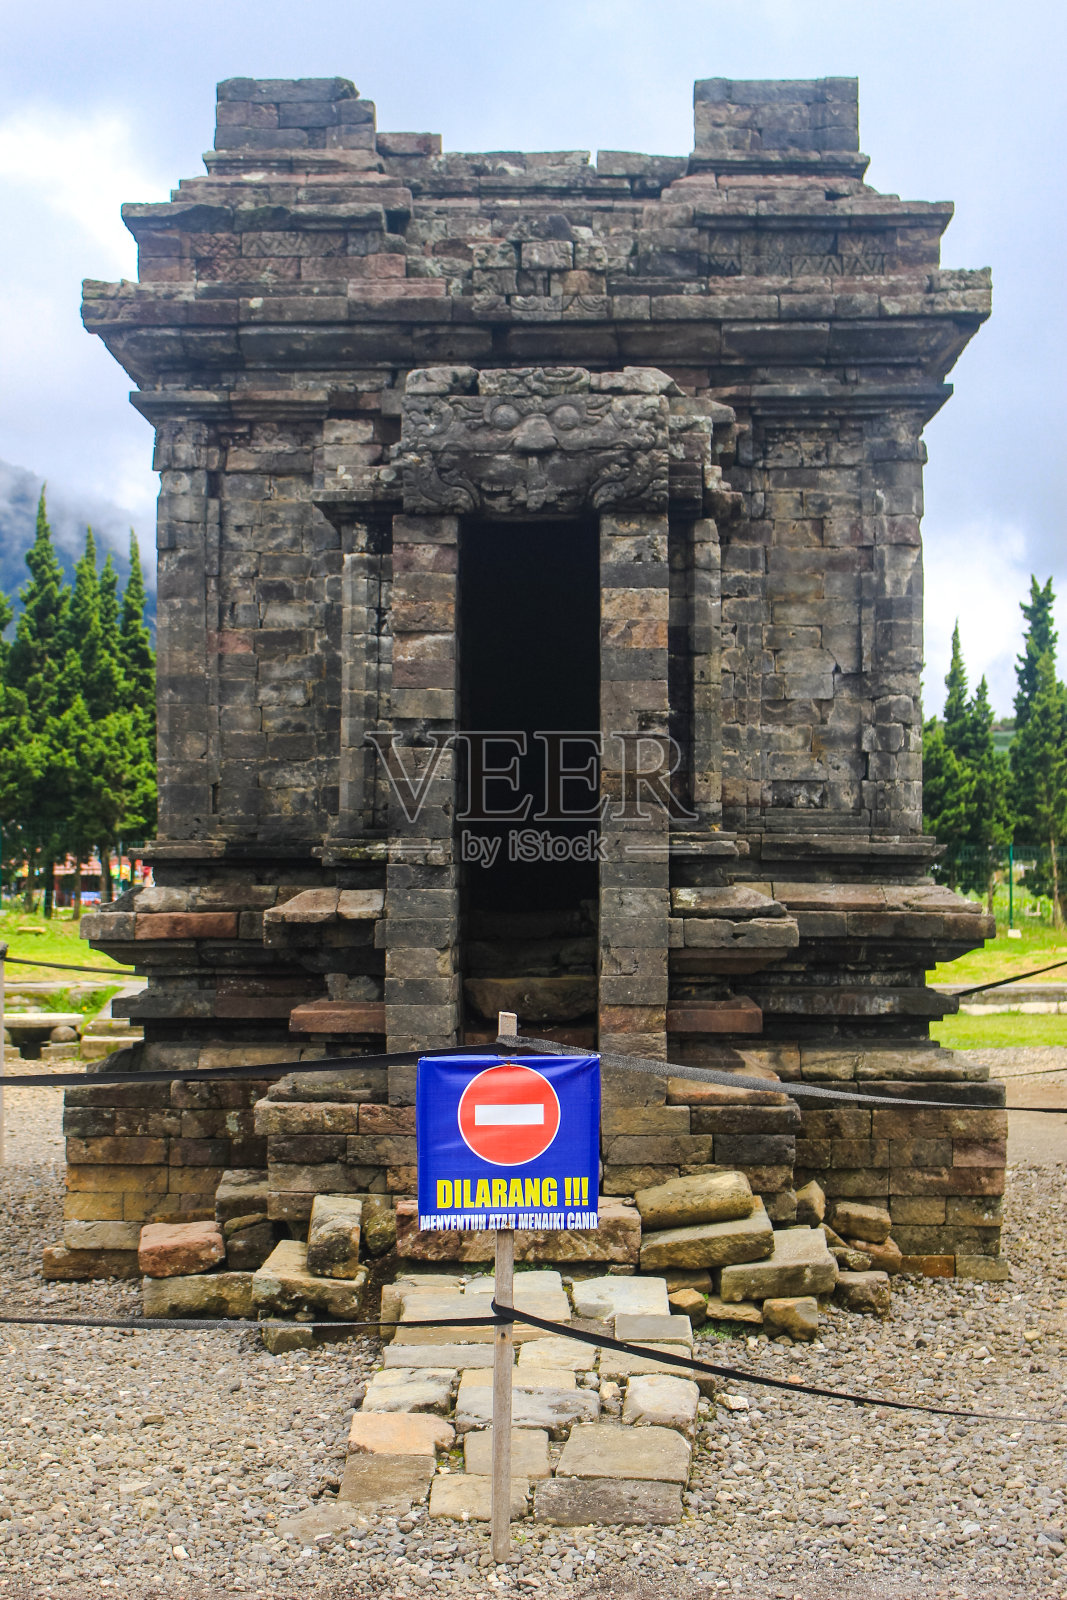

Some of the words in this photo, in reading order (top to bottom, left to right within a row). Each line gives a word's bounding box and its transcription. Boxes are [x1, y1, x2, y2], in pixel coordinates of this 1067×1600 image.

[436, 1177, 558, 1209] DILARANG
[564, 1177, 589, 1206] !!!
[420, 1214, 487, 1231] MENYENTUH
[518, 1212, 565, 1230] MENAIKI
